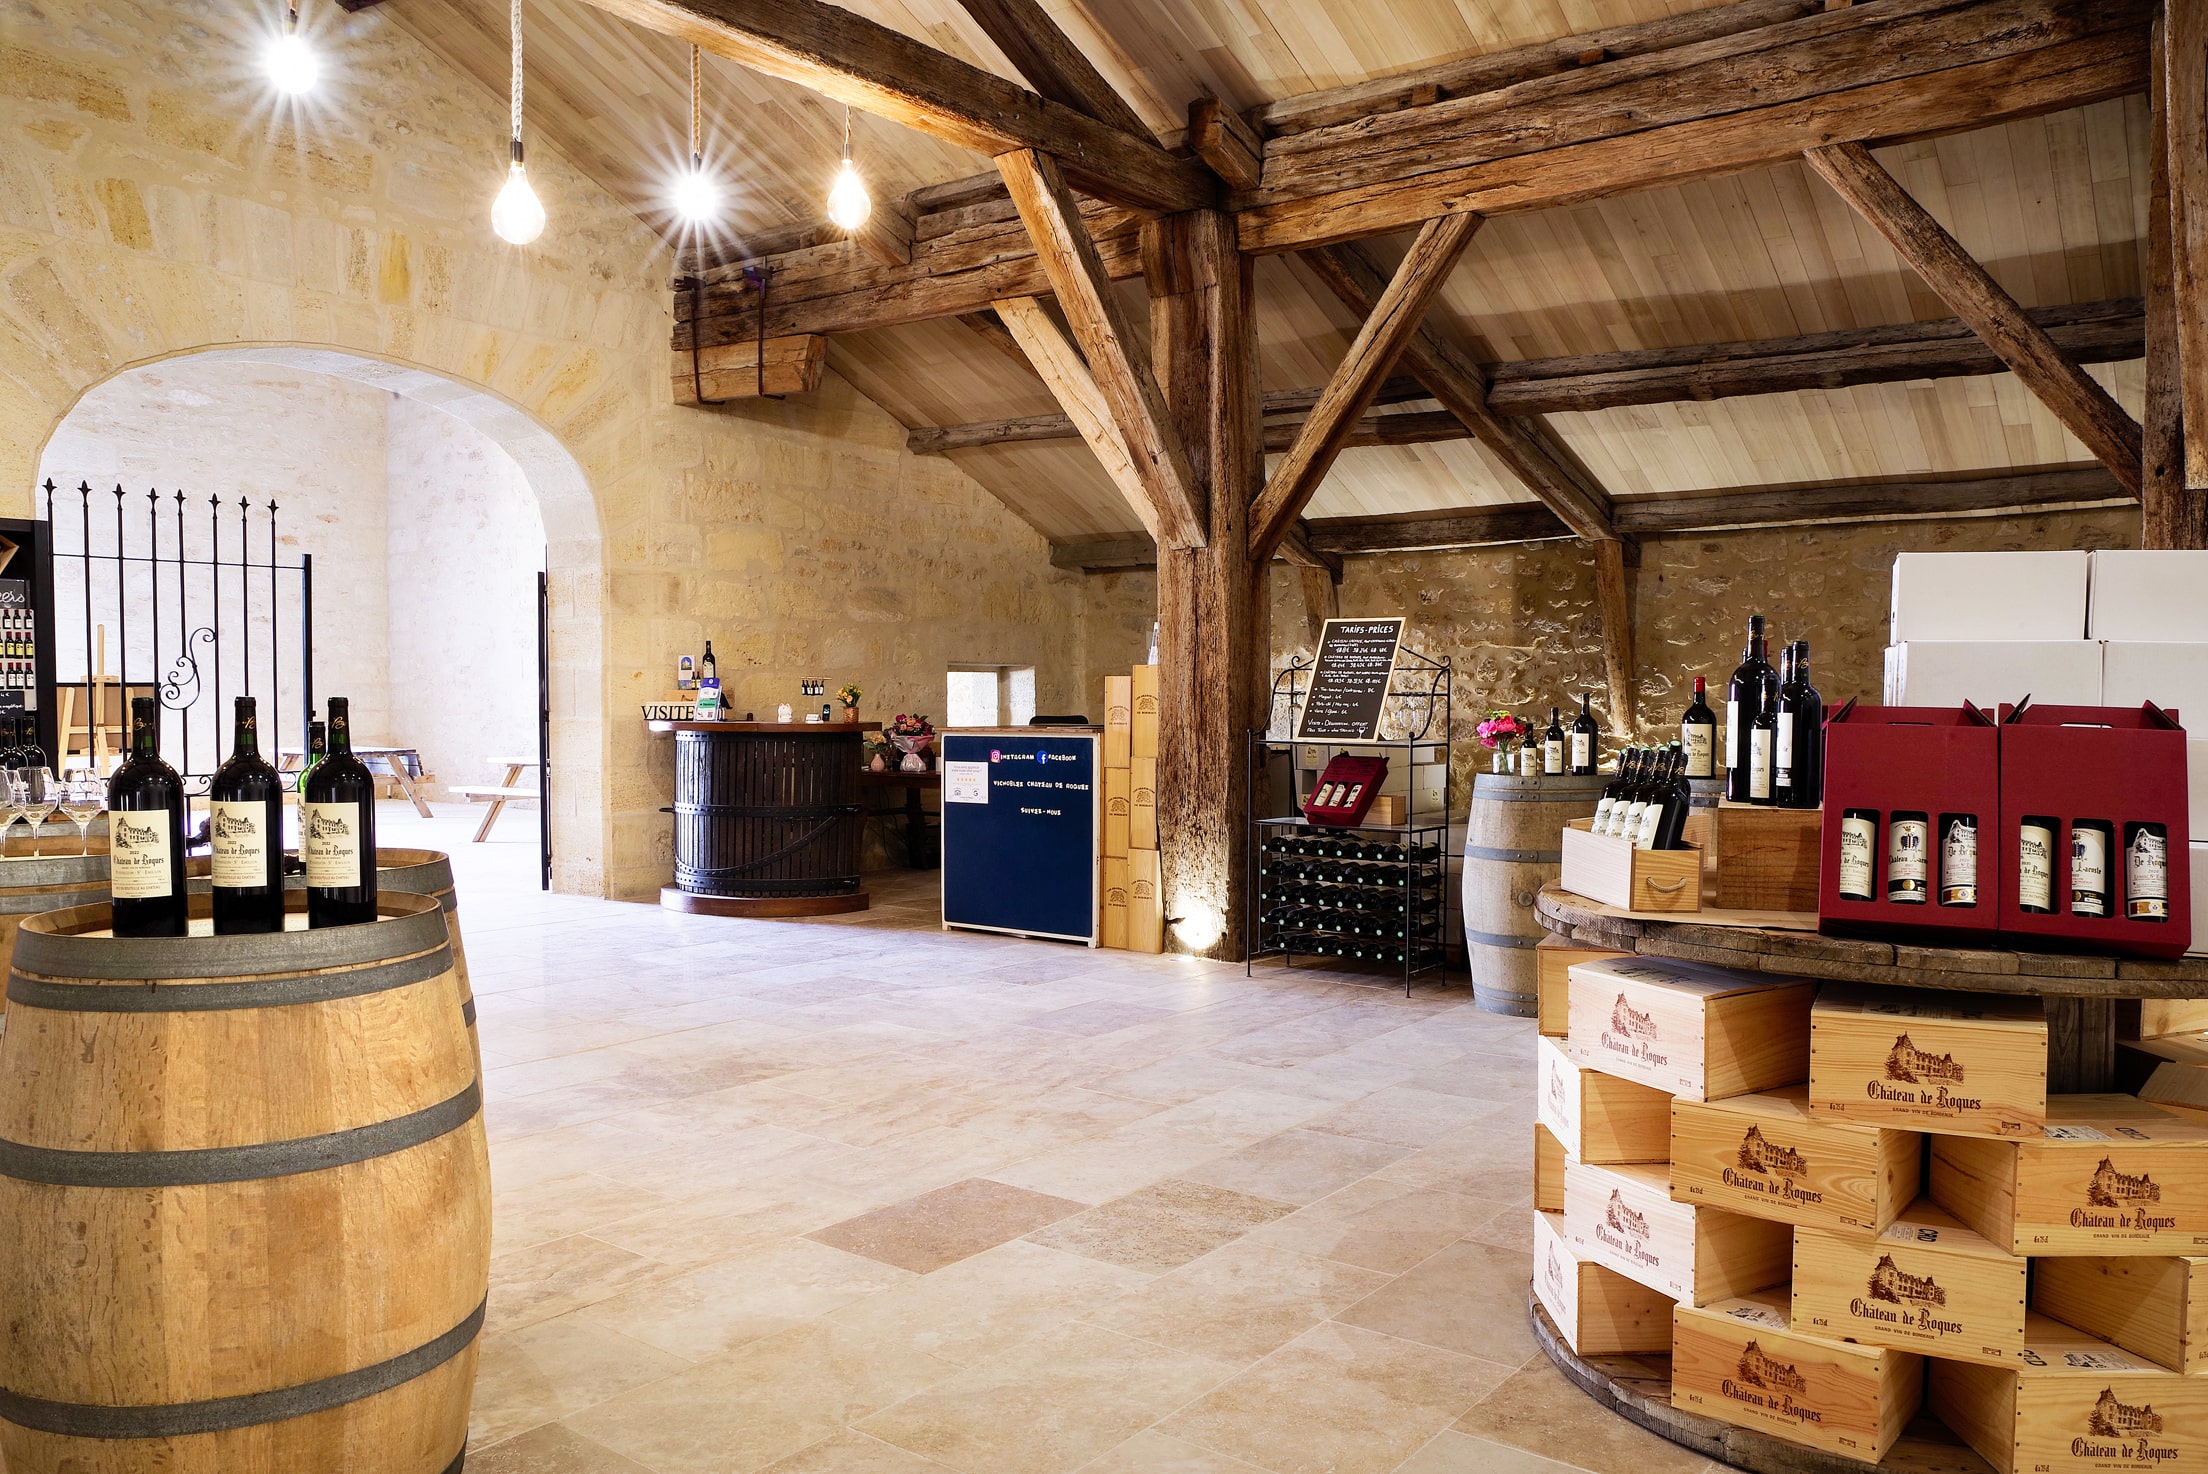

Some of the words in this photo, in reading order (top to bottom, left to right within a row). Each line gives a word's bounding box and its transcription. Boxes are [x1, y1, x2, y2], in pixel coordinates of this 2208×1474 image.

[142, 854, 164, 867] Roques
[239, 843, 260, 856] Roques
[333, 845, 353, 857] Roques
[1851, 855, 1869, 868] Roques
[2134, 855, 2145, 868] De
[2024, 866, 2030, 874] de
[2031, 865, 2049, 879] Roques
[2076, 861, 2102, 875] Lacoste
[1601, 1031, 1629, 1054] Château
[1631, 1043, 1640, 1057] de
[1641, 1042, 1668, 1067] Roques
[1867, 1080, 1915, 1103] Château
[1920, 1090, 1933, 1105] de
[1936, 1086, 1982, 1113] Roques
[1722, 1167, 1764, 1192] Château
[1768, 1180, 1779, 1195] de
[1782, 1178, 1823, 1205] Roques
[2070, 1207, 2115, 1228] Château
[2120, 1213, 2131, 1228] de
[2134, 1207, 2176, 1232] Roques
[1596, 1223, 1622, 1249] Château
[1625, 1240, 1632, 1253] de
[1634, 1240, 1660, 1266] Roques
[1850, 1297, 1897, 1322] Château
[1902, 1310, 1914, 1325] de
[1917, 1308, 1963, 1336] Roques
[1722, 1379, 1763, 1405] Château
[1768, 1395, 1779, 1410] de
[1782, 1395, 1822, 1423] Roques
[2071, 1436, 2117, 1457] Château
[2122, 1443, 2133, 1458] de
[2136, 1438, 2179, 1464] Roques
